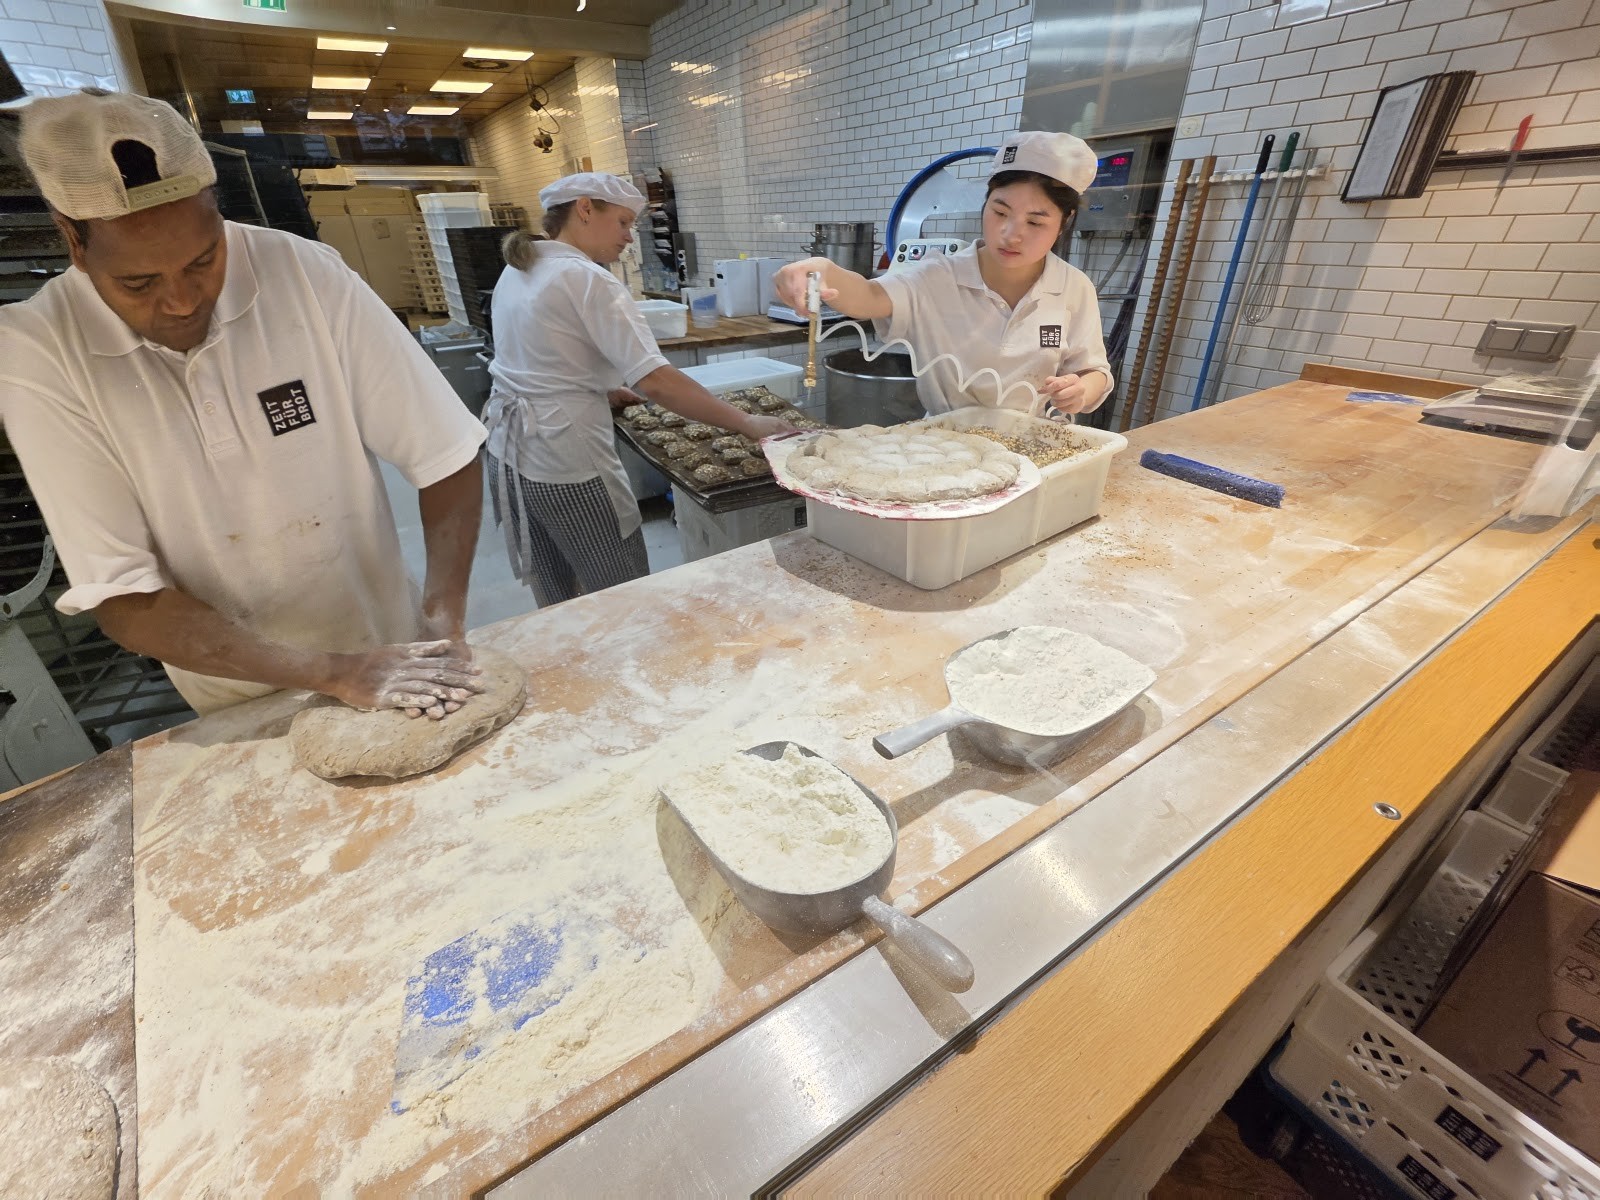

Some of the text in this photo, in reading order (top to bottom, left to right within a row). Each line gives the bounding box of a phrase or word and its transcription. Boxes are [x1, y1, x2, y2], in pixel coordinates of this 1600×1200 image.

[266, 401, 287, 431] ZEIT
[282, 399, 301, 426] FÜR
[291, 388, 311, 422] BROT
[1441, 1112, 1462, 1132] ZEIT
